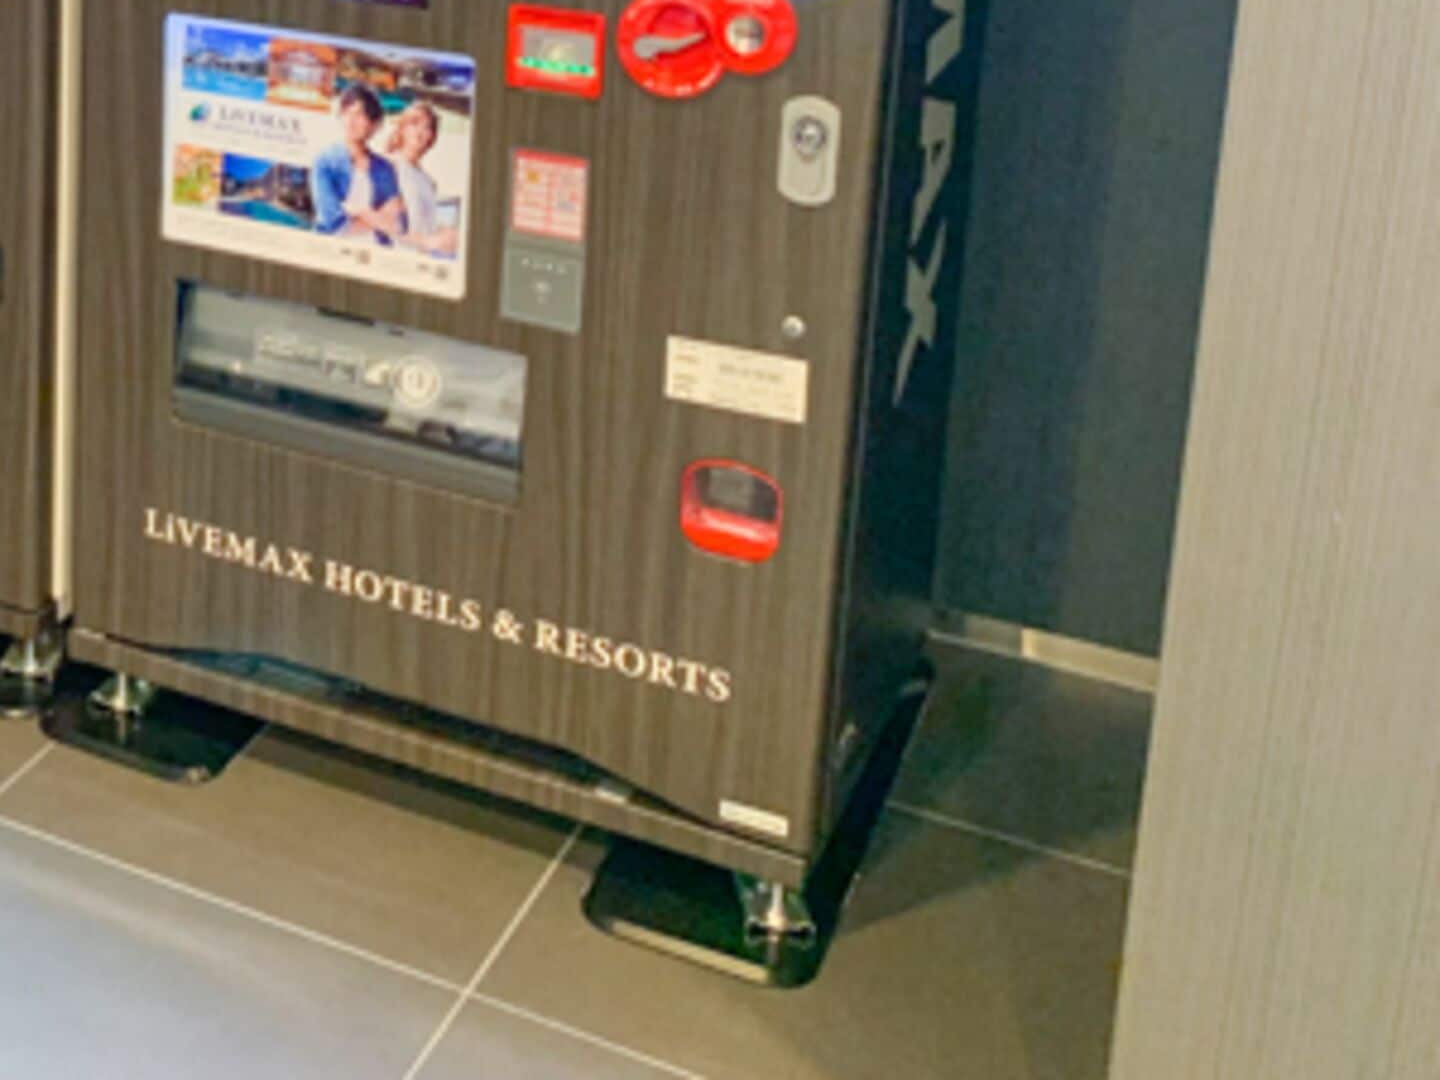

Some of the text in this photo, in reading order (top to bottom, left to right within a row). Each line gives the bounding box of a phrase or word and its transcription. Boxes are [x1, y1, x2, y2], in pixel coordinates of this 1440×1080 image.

[324, 559, 481, 631] HOTELS
[492, 608, 524, 644] &
[533, 619, 732, 703] RESORTS
